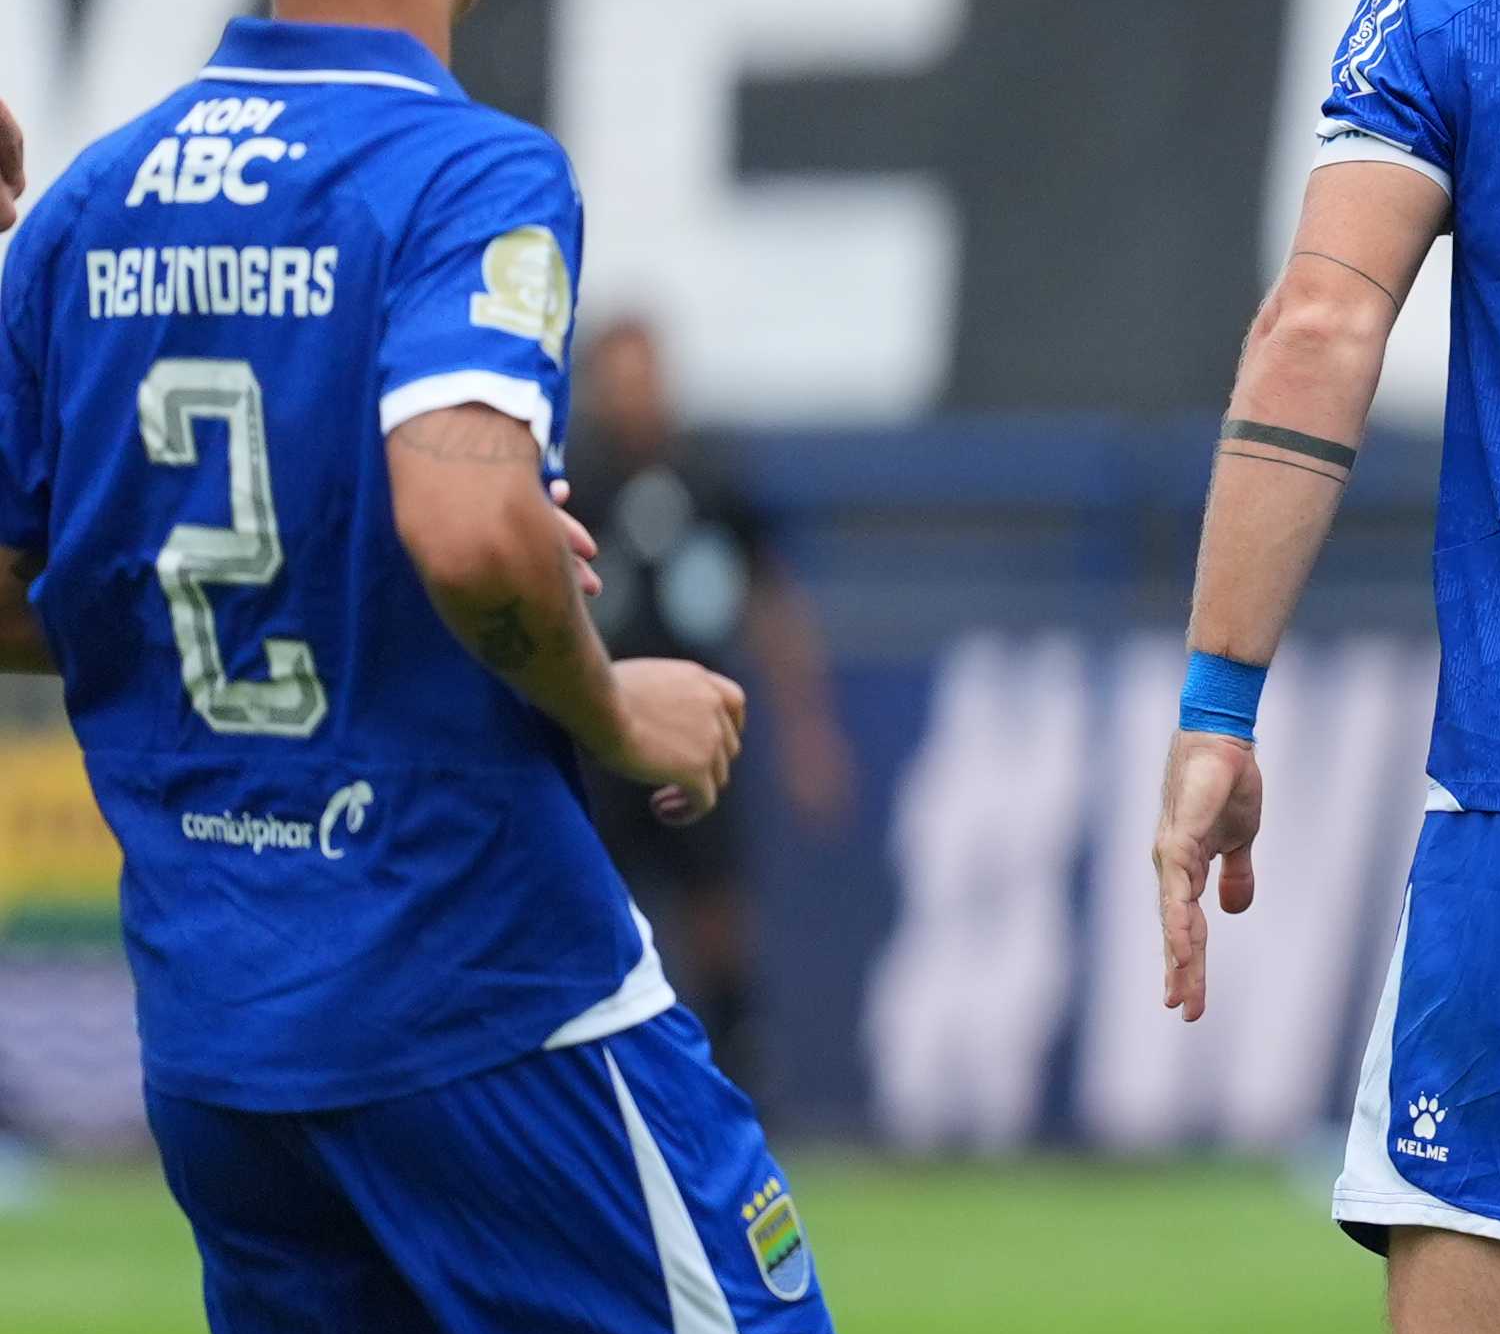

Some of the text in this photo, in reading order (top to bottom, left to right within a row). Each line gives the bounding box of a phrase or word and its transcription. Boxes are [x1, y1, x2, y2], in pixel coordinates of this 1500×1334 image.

[175, 97, 287, 135] KOPI
[86, 245, 338, 319] REIJNDERS
[137, 357, 328, 738] 2
[181, 807, 314, 855] combiphar
[1397, 1137, 1449, 1163] KELME
